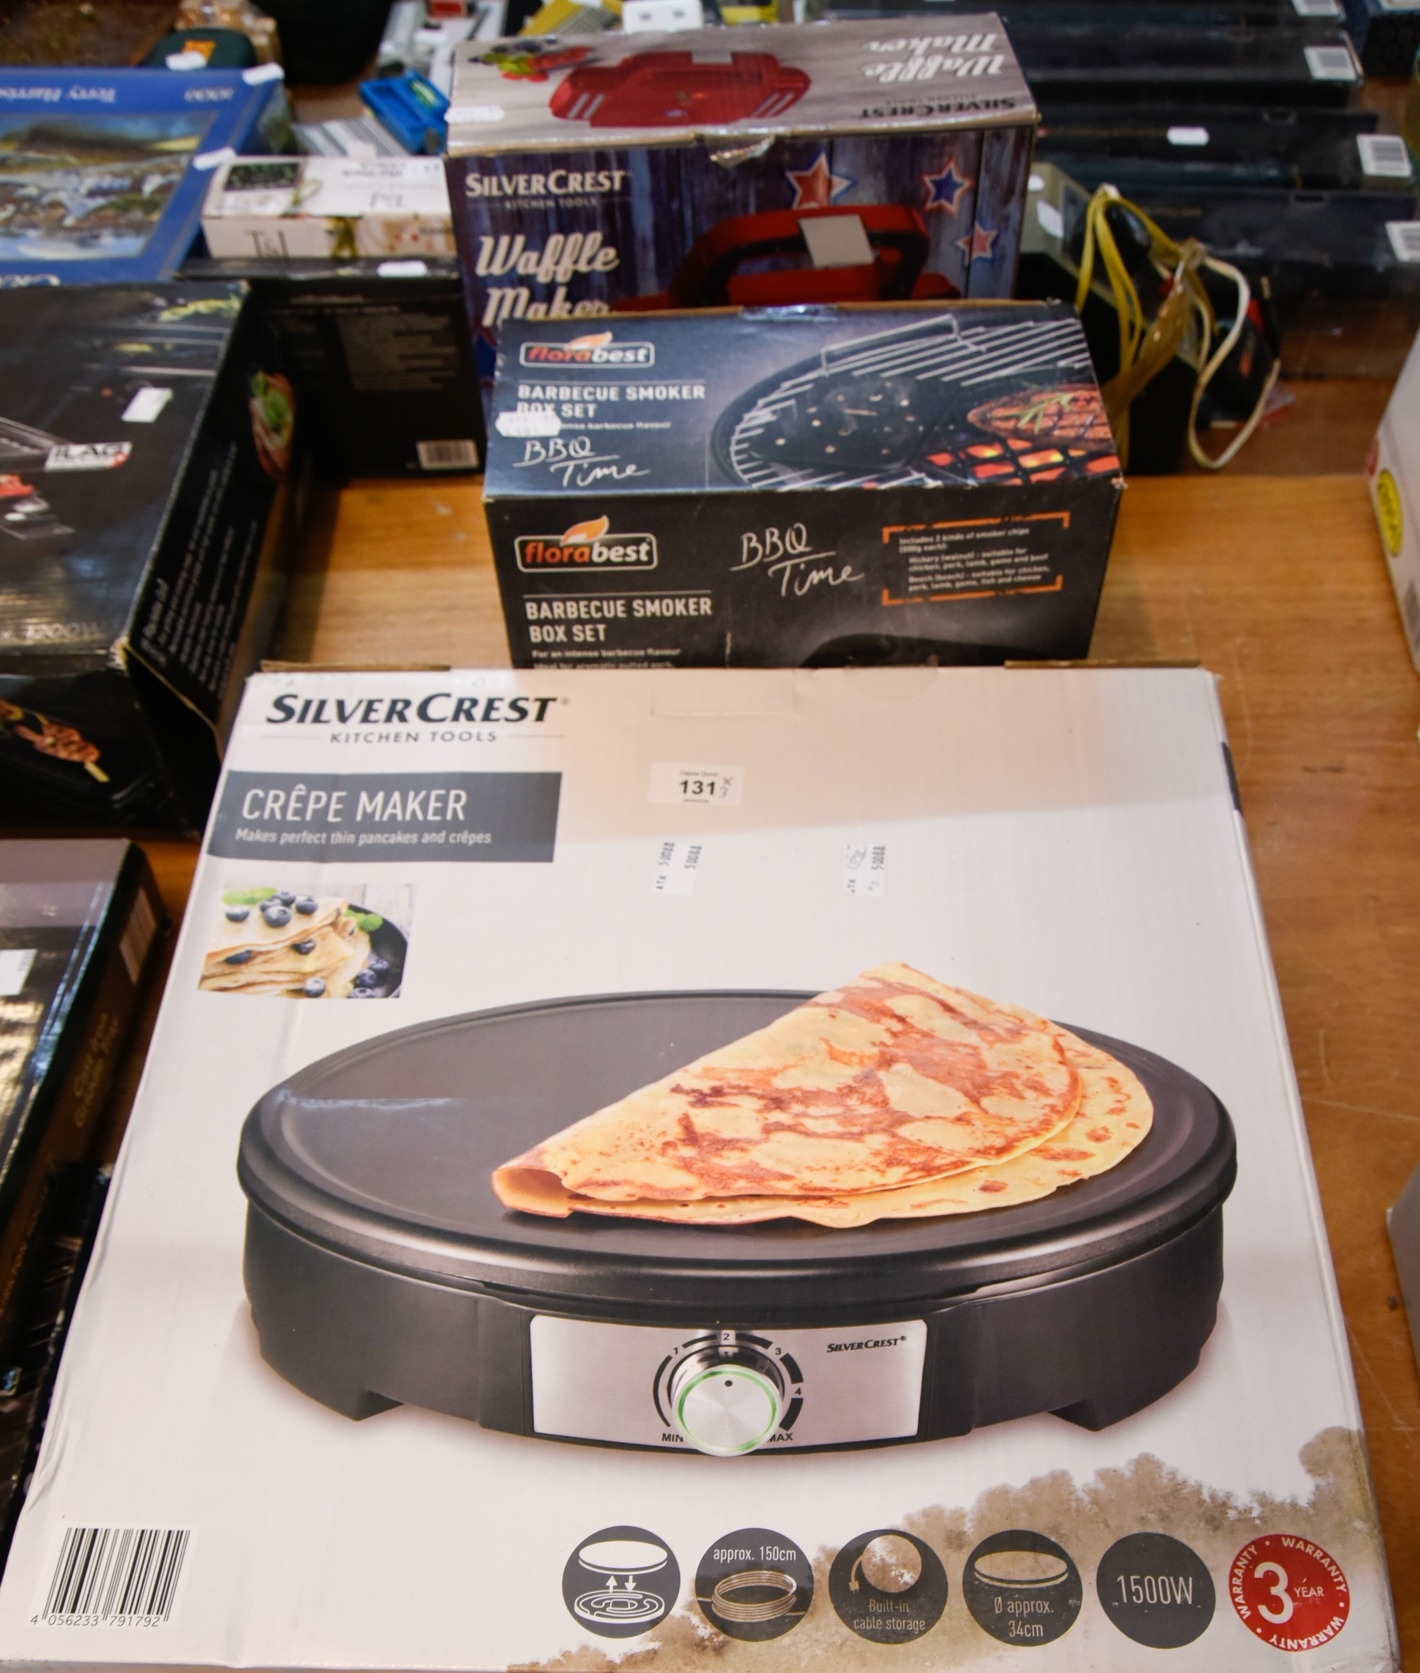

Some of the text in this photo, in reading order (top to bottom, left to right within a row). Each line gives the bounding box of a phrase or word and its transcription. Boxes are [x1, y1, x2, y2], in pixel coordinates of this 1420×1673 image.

[861, 54, 1005, 83] Waffle
[859, 97, 1016, 118] SILVERCREST
[464, 168, 626, 198] SILVERCREST
[475, 231, 621, 284] Waffle
[481, 285, 612, 328] Maker
[526, 345, 649, 364] florabest
[517, 384, 706, 401] BARBECUE SMOKER
[560, 402, 597, 419] SET
[512, 436, 594, 468] BBQ
[550, 454, 652, 488] Time
[524, 540, 651, 564] florabest
[730, 523, 813, 571] BBQ
[767, 552, 866, 597] Time
[525, 597, 713, 621] BARBECUE SMOKER
[530, 623, 607, 643] BOX SET
[265, 692, 557, 725] SILVERCREST
[330, 730, 499, 744] KITCHEN TOOLS
[679, 779, 716, 796] 131
[241, 784, 468, 822] CRÊPE MAKER
[235, 828, 493, 846] Makes perfect thin pancakes and crêpes
[722, 1332, 730, 1342] 2
[826, 1338, 899, 1353] SILVERCREST
[673, 1347, 679, 1356] 1
[775, 1346, 782, 1356] 3
[794, 1387, 802, 1396] 4
[661, 1432, 793, 1443] MIN MAX
[713, 1545, 797, 1562] approx. 150cm
[1280, 1537, 1348, 1594] WARRANTY
[1116, 1574, 1194, 1605] 1500W
[1231, 1543, 1260, 1621] WARRANTY
[1253, 1561, 1294, 1626] 3
[1293, 1586, 1325, 1599] YEAR
[868, 1597, 910, 1613] Built-in
[1007, 1598, 1055, 1616] approx.
[29, 1614, 161, 1628] 4 056233 791792
[853, 1616, 926, 1632] cable storage
[1008, 1620, 1044, 1638] 34cm
[1268, 1617, 1346, 1652] WARRANTY
